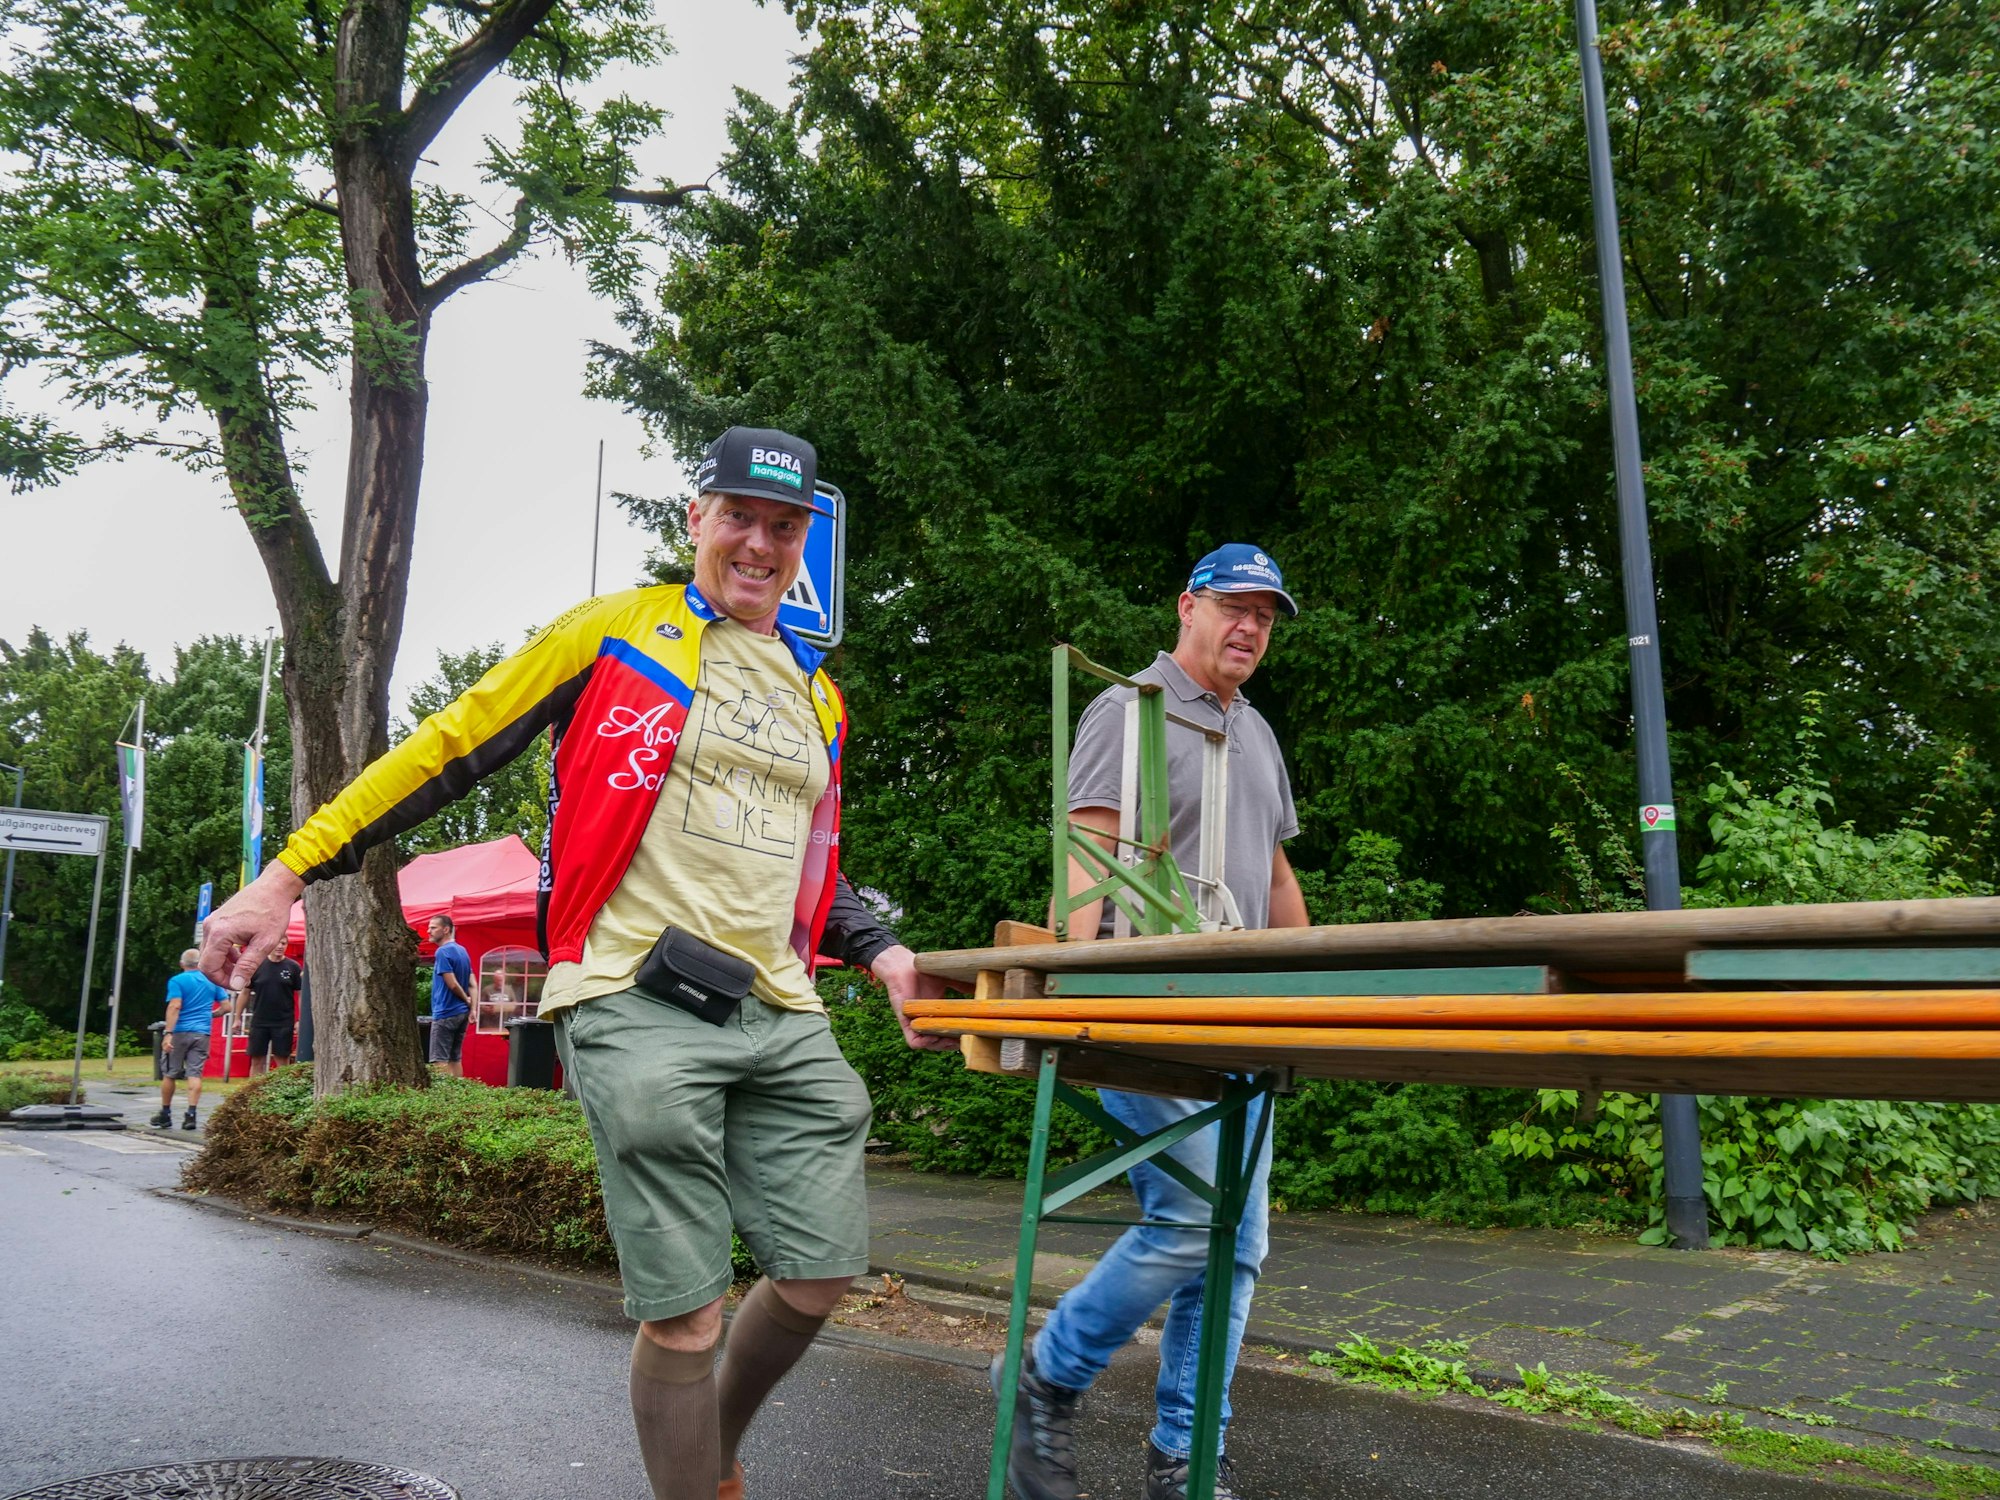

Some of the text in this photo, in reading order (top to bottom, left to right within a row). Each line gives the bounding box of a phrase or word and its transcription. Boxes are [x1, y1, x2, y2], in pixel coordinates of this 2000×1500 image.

[751, 448, 802, 474] BORA
[753, 464, 801, 485] hansgrohe
[1629, 635, 1649, 646] 7021
[710, 761, 768, 799] MEN
[773, 783, 793, 805] IN
[715, 793, 775, 846] BIKE
